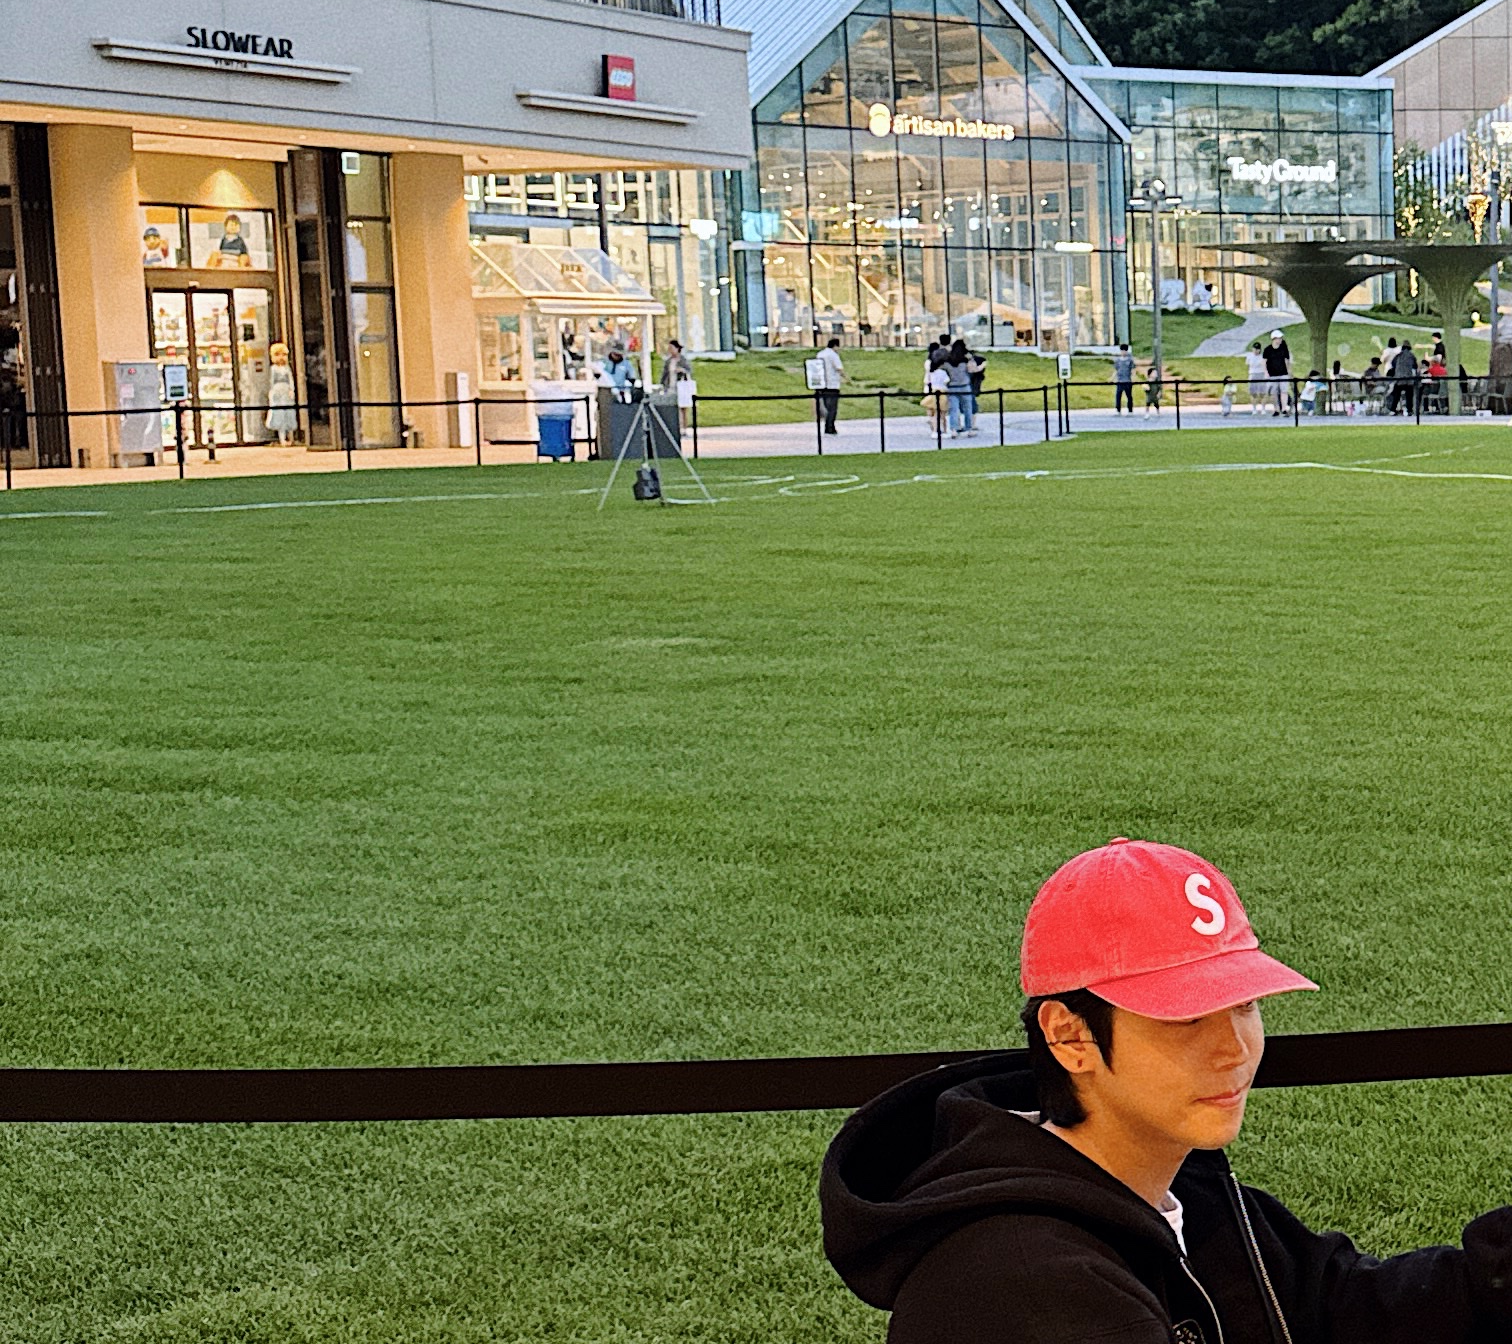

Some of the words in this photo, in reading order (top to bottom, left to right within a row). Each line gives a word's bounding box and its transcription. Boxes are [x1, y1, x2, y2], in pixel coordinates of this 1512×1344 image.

[186, 26, 294, 59] SLOWEAR
[956, 117, 1015, 141] bakers
[1227, 156, 1272, 185] Tasty
[1273, 158, 1336, 183] Ground
[1184, 872, 1226, 936] S
